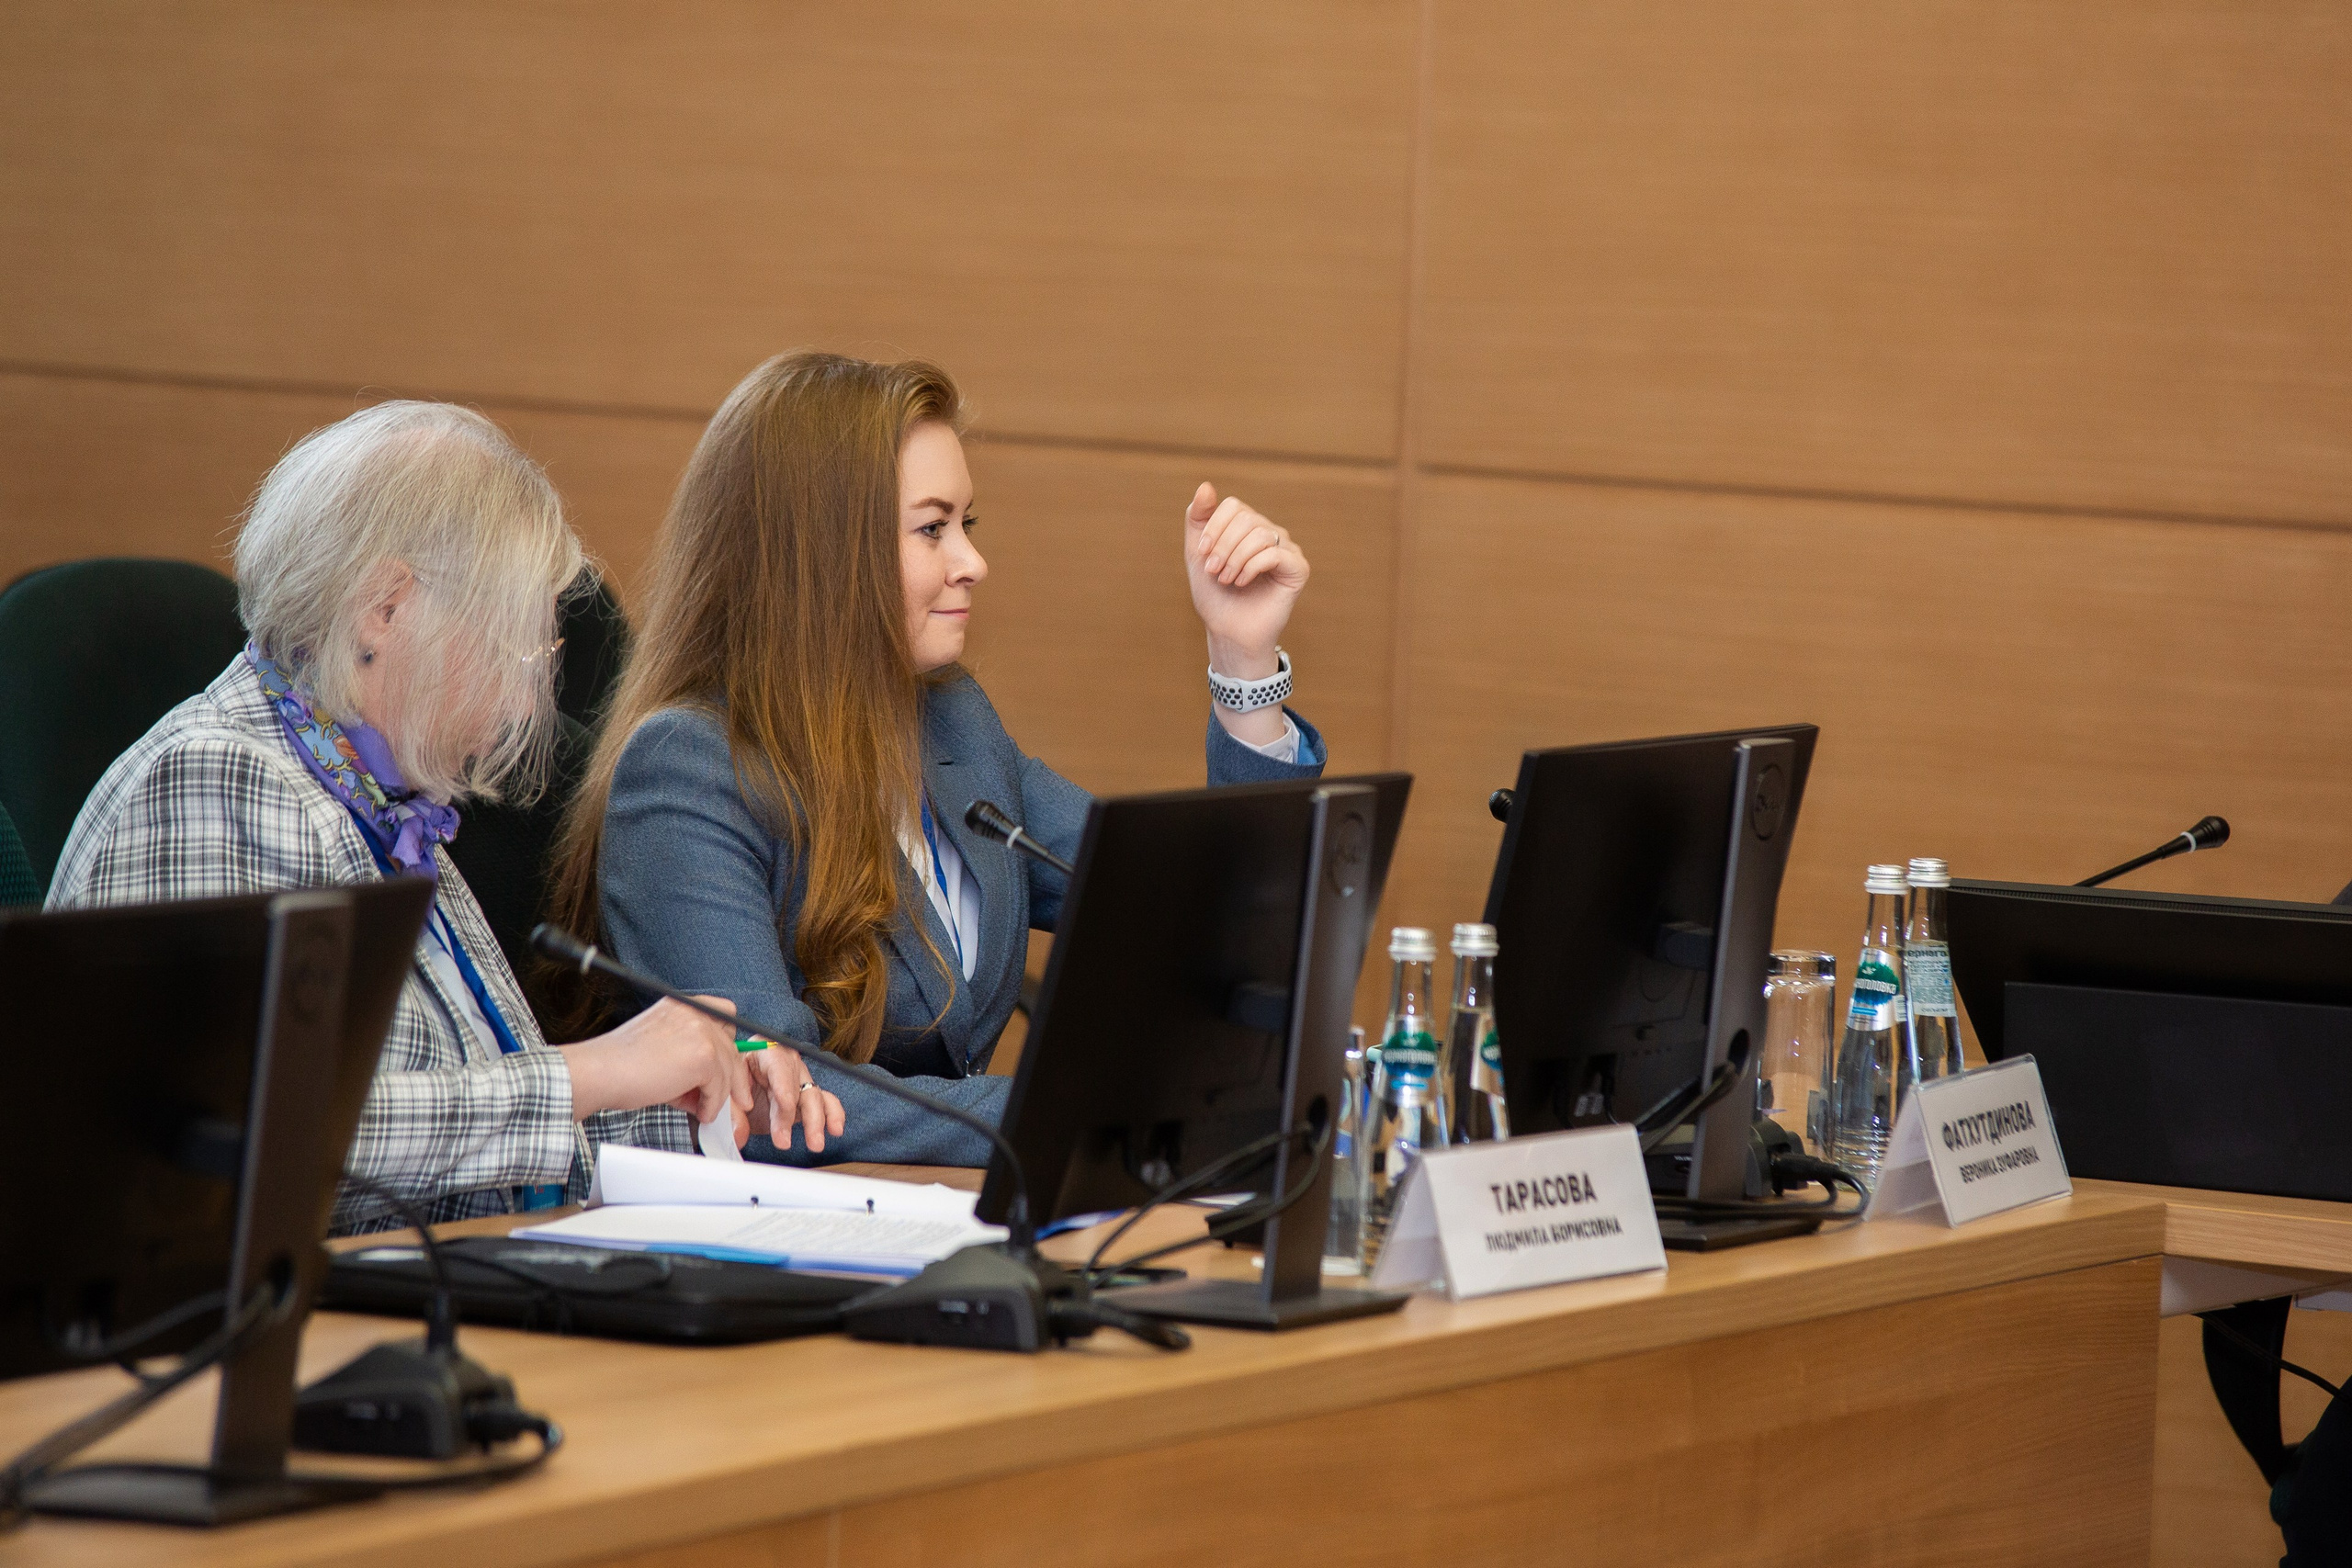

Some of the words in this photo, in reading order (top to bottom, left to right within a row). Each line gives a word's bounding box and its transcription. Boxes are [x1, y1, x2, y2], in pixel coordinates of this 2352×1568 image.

[1941, 1100, 2037, 1153] ФАТХУТДИНОВА
[1959, 1157, 2000, 1184] ВЕРОНИКА
[1996, 1145, 2041, 1174] ЗУФАРОВНА
[1490, 1171, 1598, 1215] ТАРАСОВА
[1486, 1226, 1550, 1252] ЛЮДМИЛА
[1550, 1216, 1623, 1243] БОРИСОВНА
